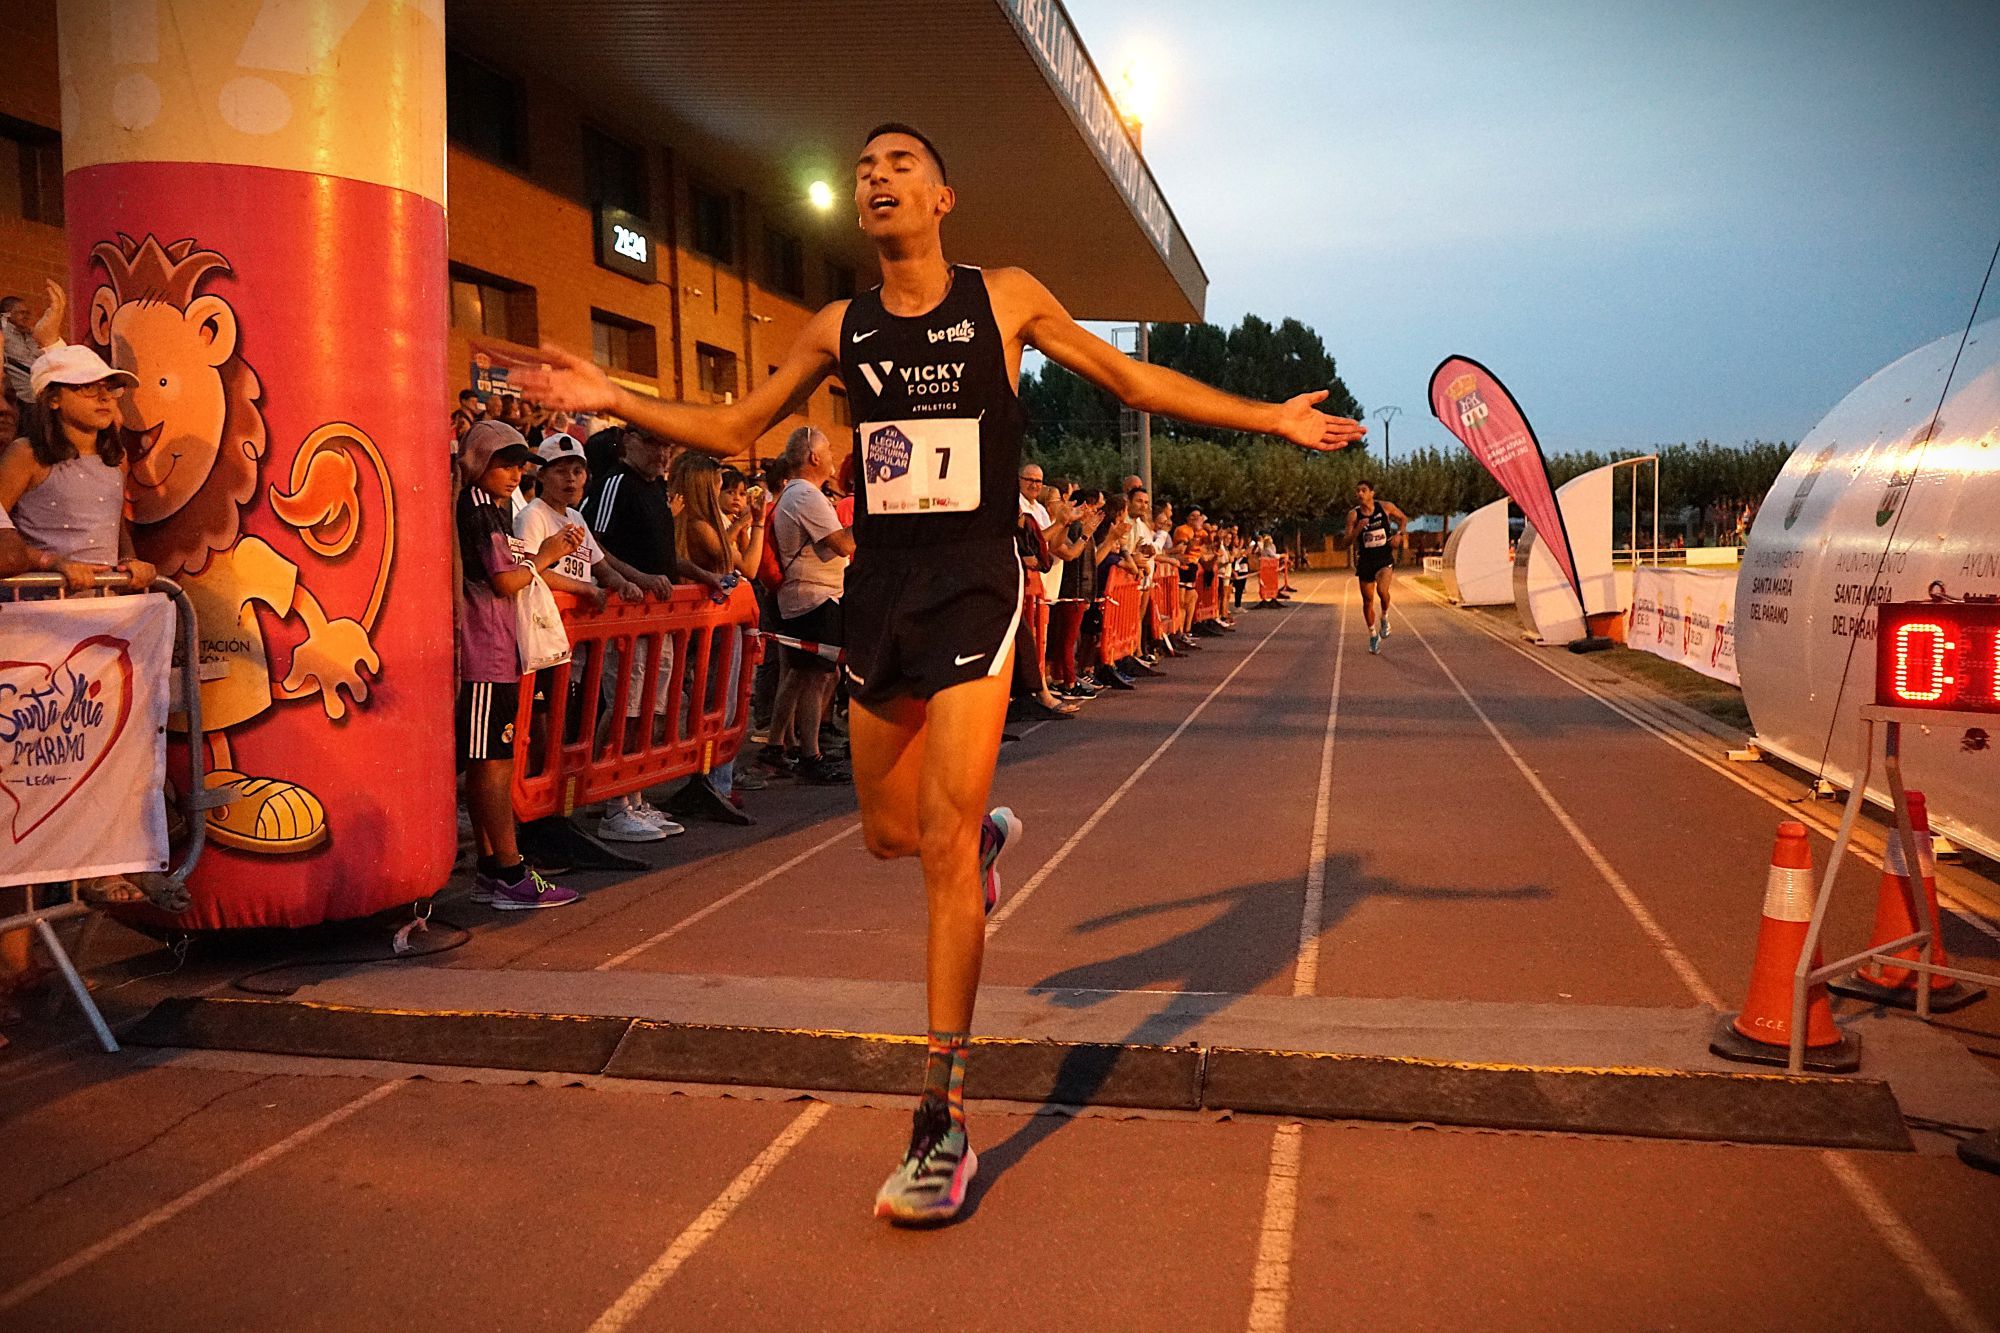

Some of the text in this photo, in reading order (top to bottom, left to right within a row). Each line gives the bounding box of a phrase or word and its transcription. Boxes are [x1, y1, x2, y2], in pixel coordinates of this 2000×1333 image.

[927, 319, 975, 344] be plus
[899, 362, 966, 383] VICKY
[907, 380, 960, 396] FOODS
[912, 402, 957, 412] ATHLETICS
[869, 444, 909, 460] NOCTURNA
[875, 435, 906, 450] LEGUA
[869, 451, 908, 469] POPULAR
[935, 447, 951, 480] 7
[564, 557, 584, 578] 398
[1960, 552, 2000, 578] AYUN
[1752, 577, 1772, 594] SANTA
[1833, 581, 1892, 607] SANTA MARÍA
[1751, 603, 1761, 620] DEL
[1832, 612, 1878, 640] DEL PÁRAM
